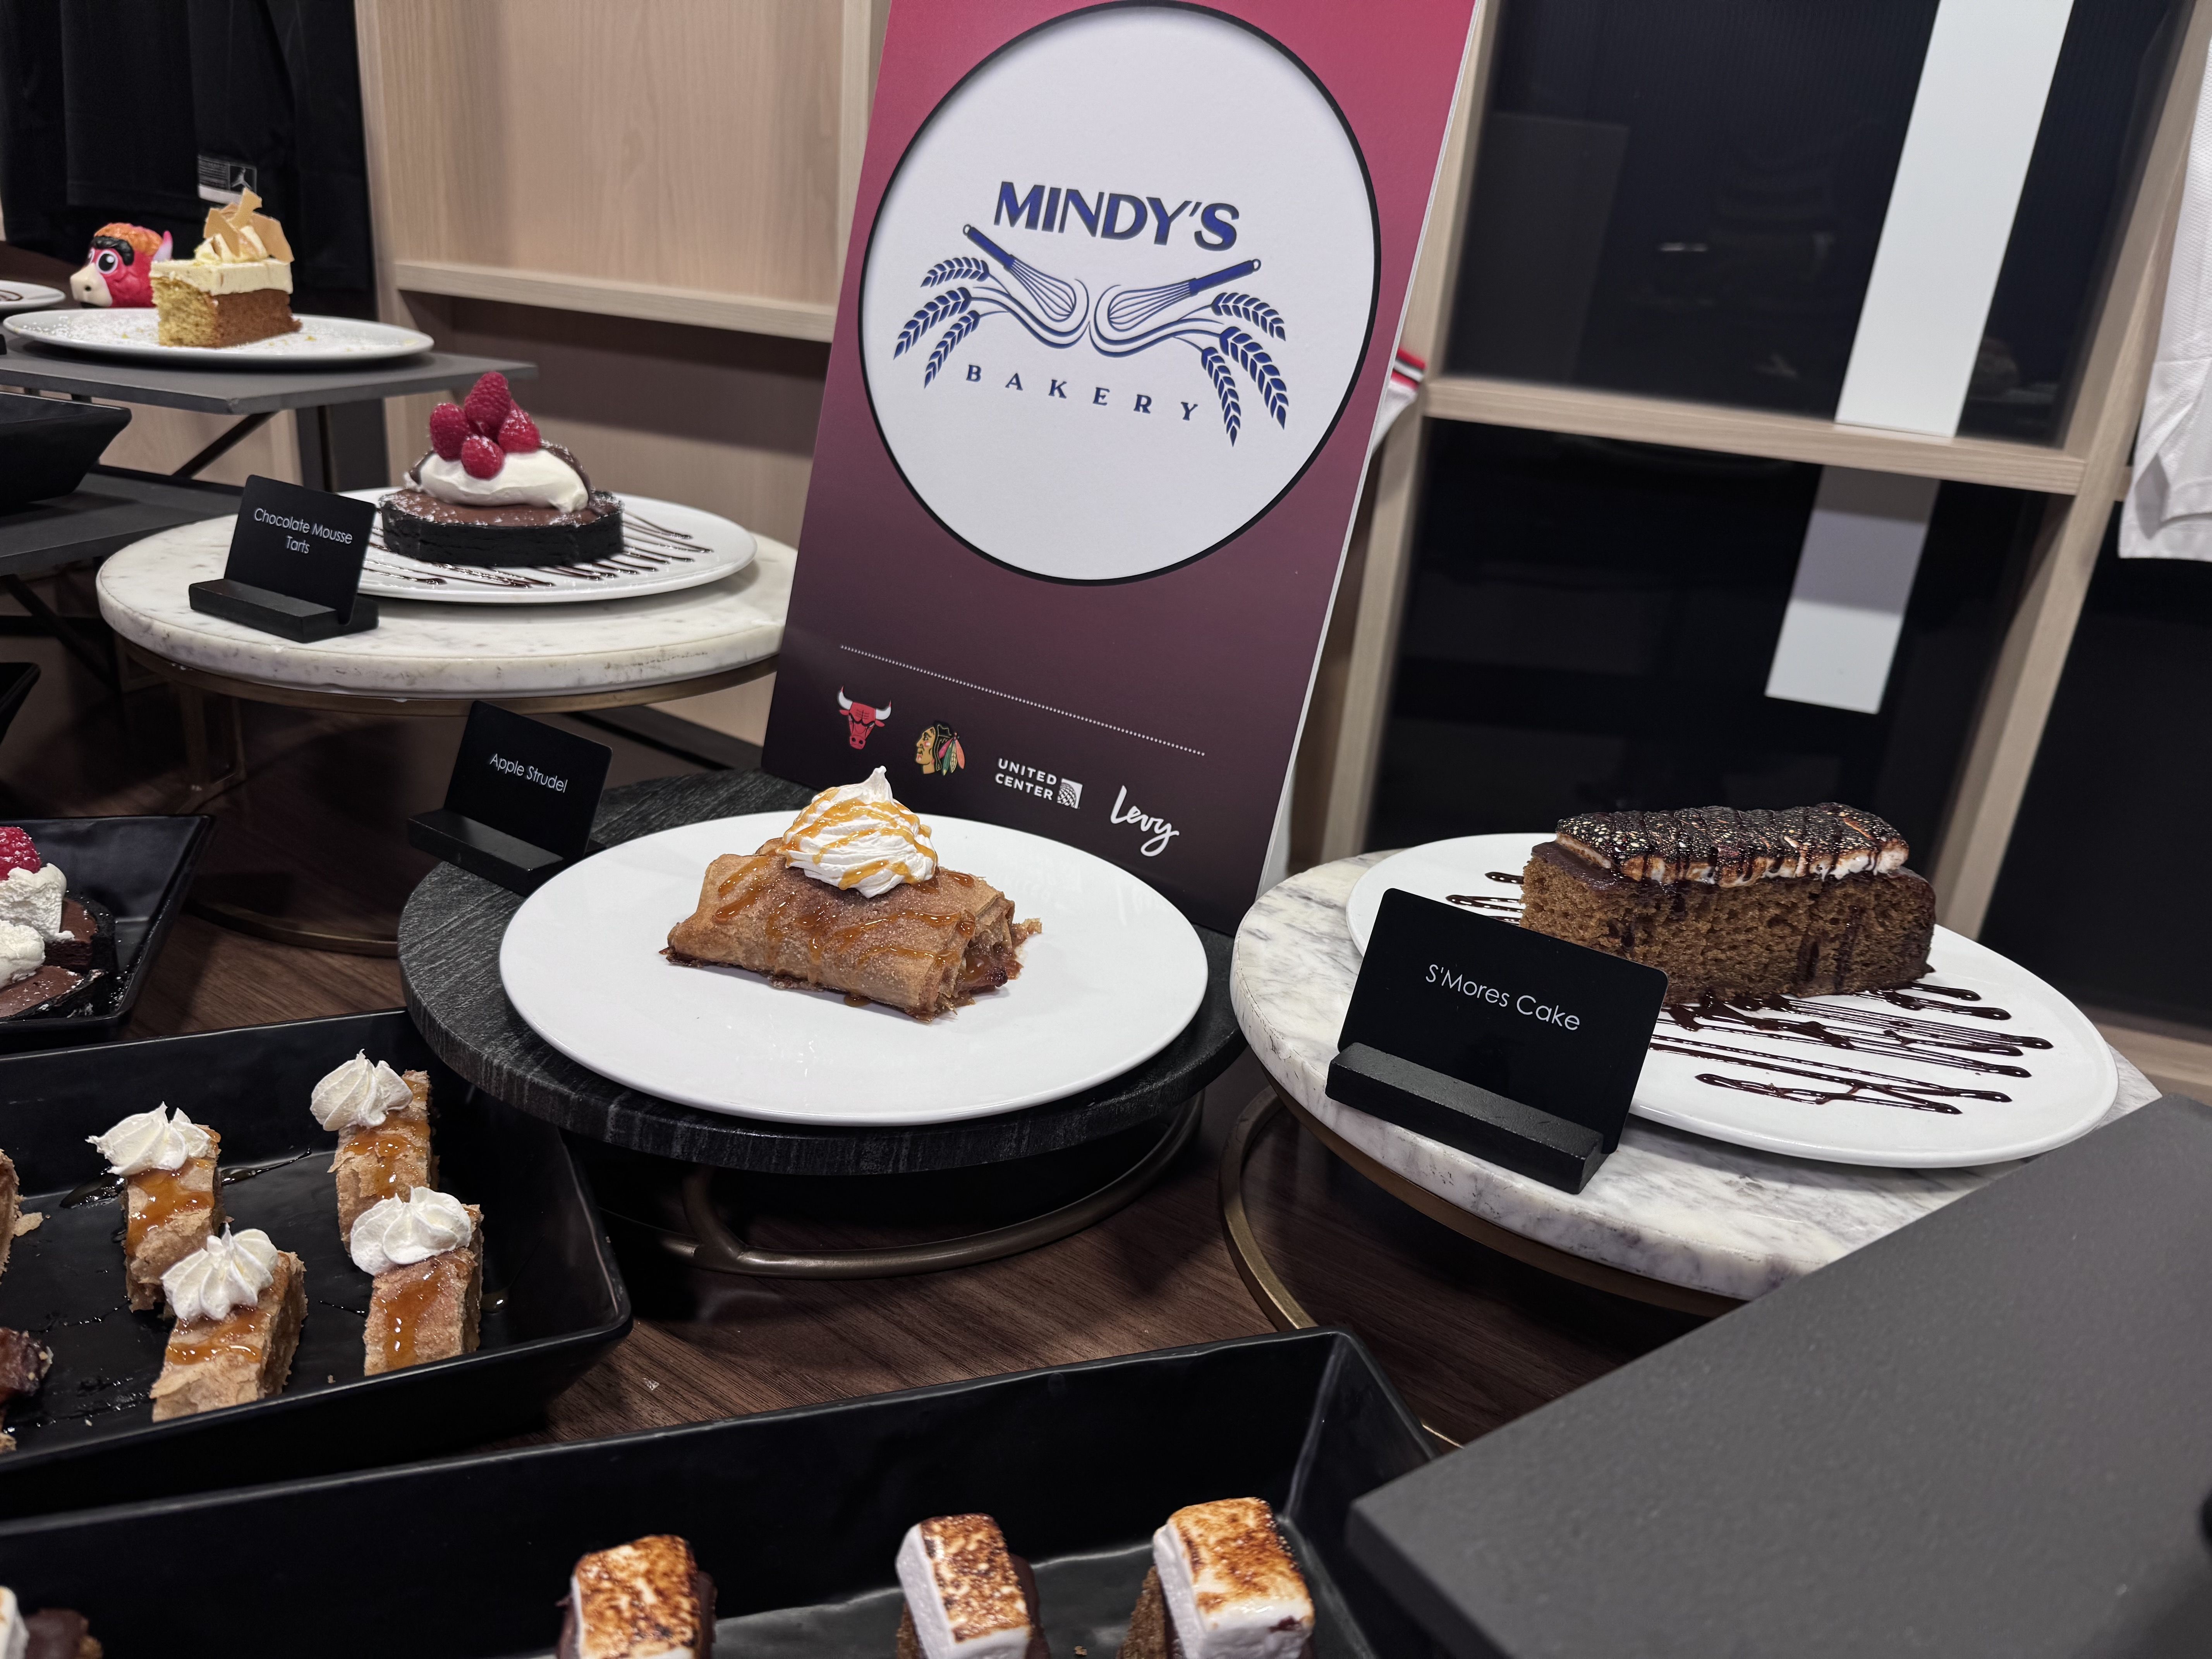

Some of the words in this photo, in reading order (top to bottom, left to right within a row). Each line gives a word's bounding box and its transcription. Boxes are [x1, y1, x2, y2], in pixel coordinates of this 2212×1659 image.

[994, 182, 1240, 251] MINDY'S
[966, 364, 1199, 421] BAKERY
[254, 508, 310, 535] Chocolate
[312, 522, 353, 544] Mousse
[286, 536, 310, 555] Tarts
[489, 753, 525, 778] Apple
[527, 765, 568, 793] Strudel
[995, 773, 1053, 801] CENTER
[998, 758, 1057, 786] UNITED
[1110, 785, 1179, 857] Levy
[1425, 964, 1510, 1008] S'Mores
[1516, 994, 1580, 1032] Cake
